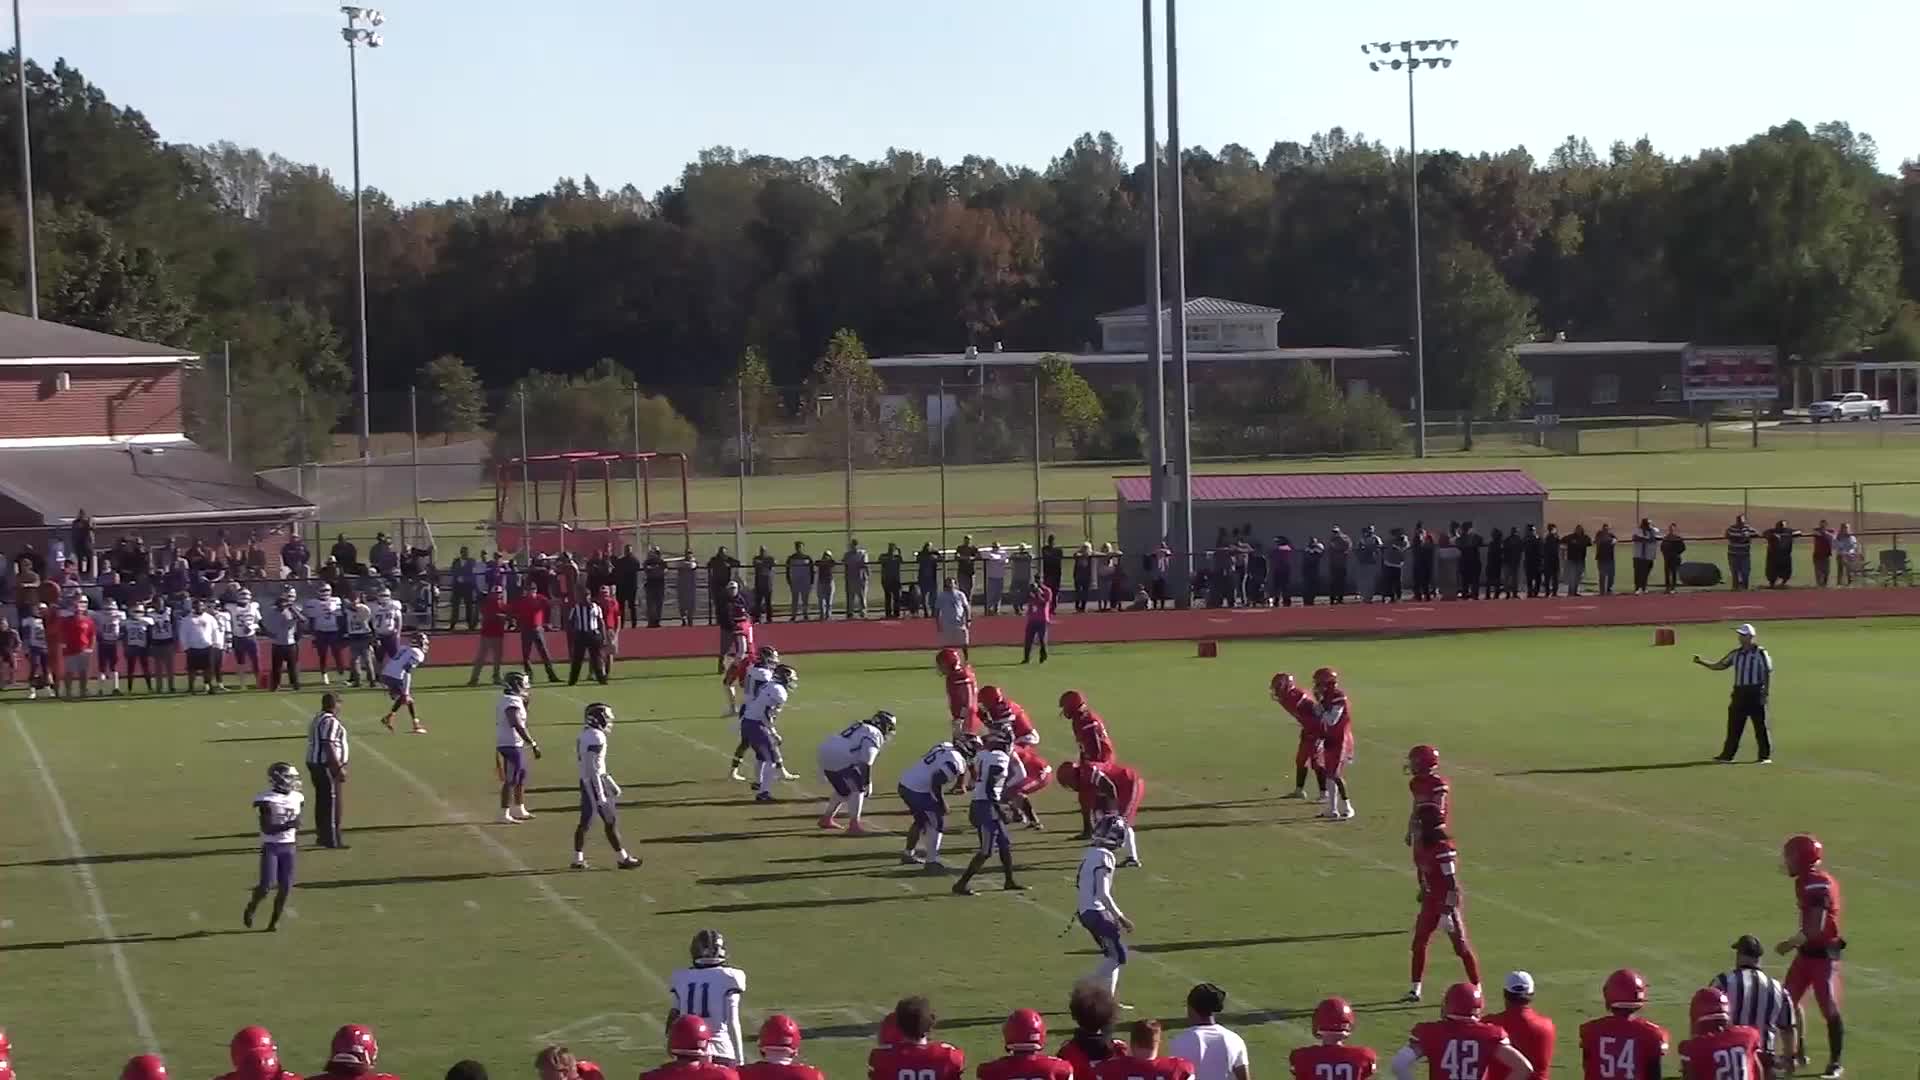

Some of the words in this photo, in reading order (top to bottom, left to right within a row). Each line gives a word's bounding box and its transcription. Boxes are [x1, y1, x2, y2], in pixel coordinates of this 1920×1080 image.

[687, 982, 712, 1018] 11
[1440, 1039, 1479, 1080] 42
[1599, 1036, 1635, 1079] 54
